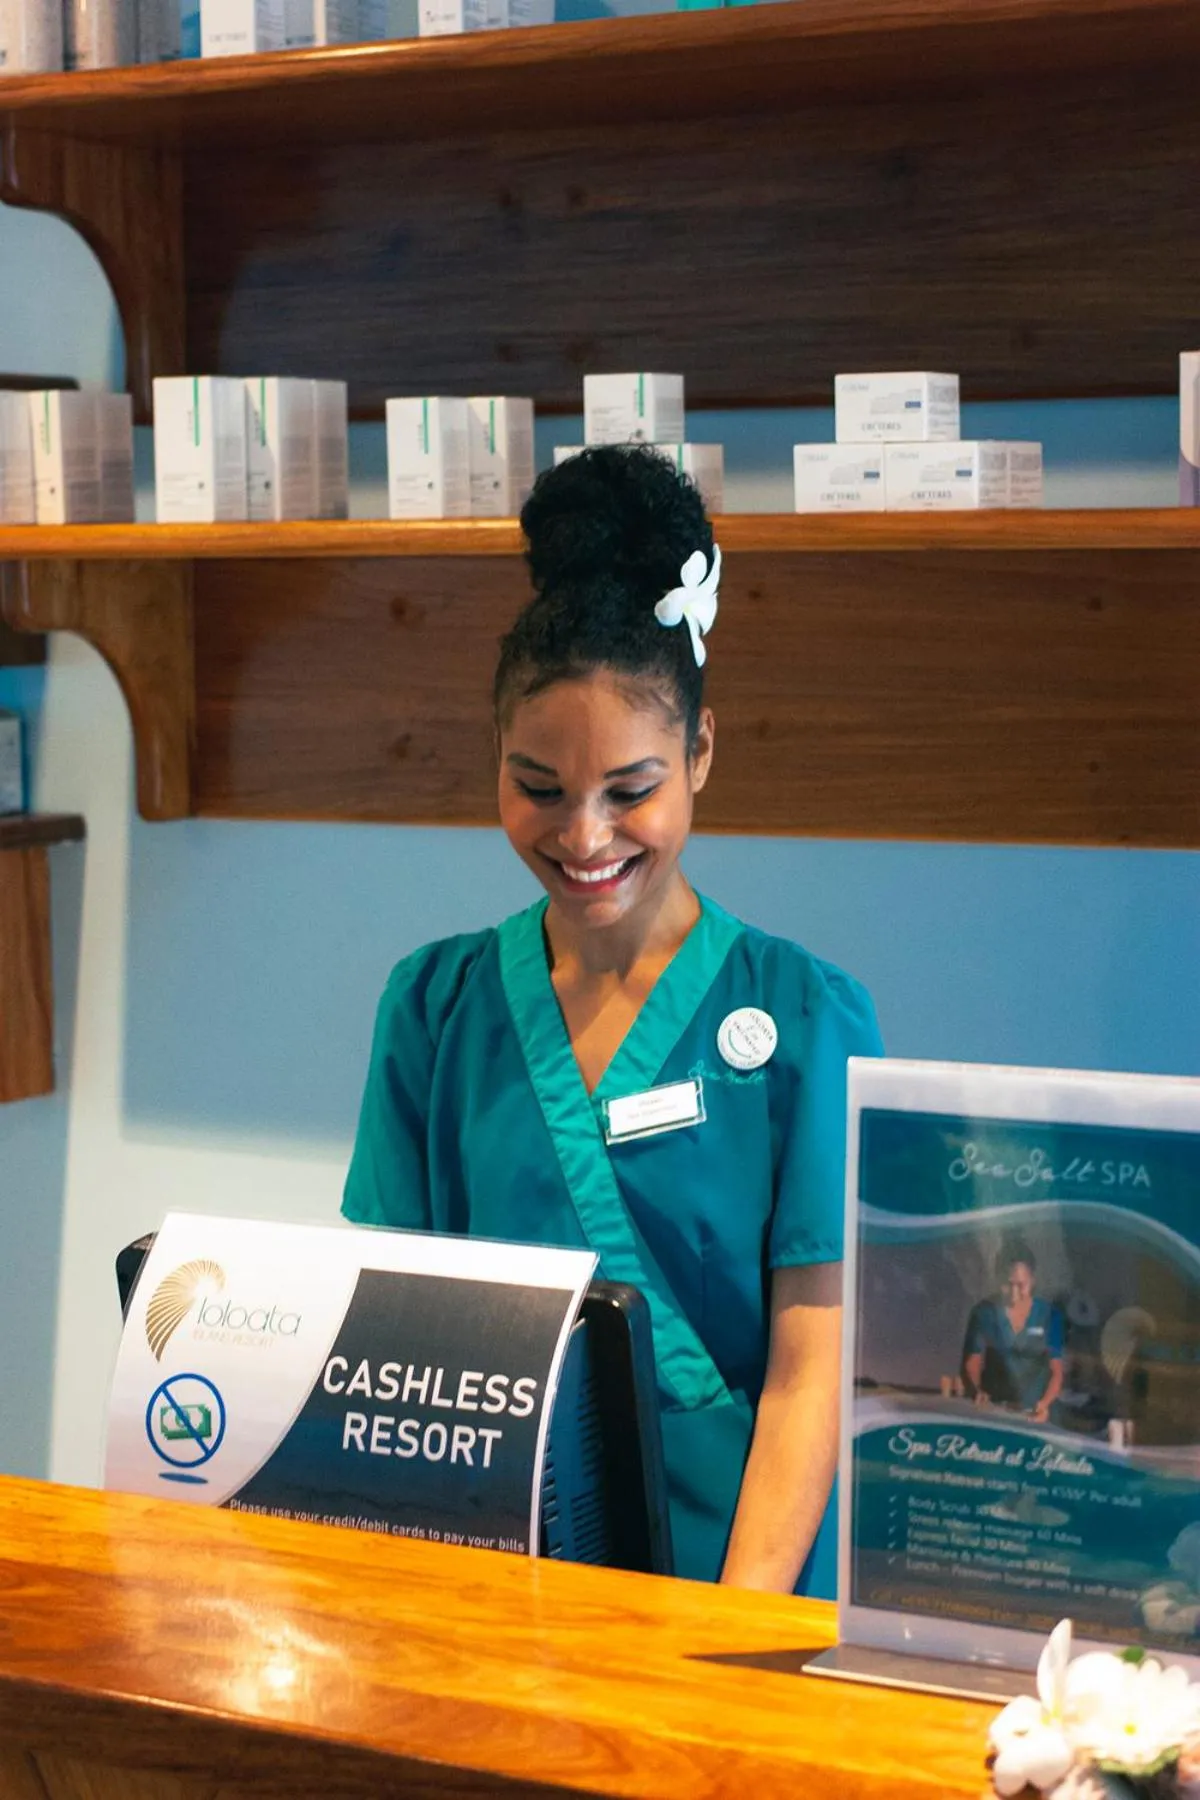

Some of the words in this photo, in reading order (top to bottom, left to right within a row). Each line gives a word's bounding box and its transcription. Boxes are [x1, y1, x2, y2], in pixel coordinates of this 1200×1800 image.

[949, 1143, 1012, 1181] Sea
[1014, 1149, 1095, 1187] Salt
[1101, 1161, 1151, 1188] SPA
[197, 1296, 302, 1336] loloata
[322, 1355, 538, 1418] CASHLESS
[342, 1411, 503, 1469] RESORT
[888, 1428, 931, 1460] Spa
[229, 1499, 267, 1517] Please
[271, 1506, 291, 1520] use
[294, 1511, 320, 1524] your
[323, 1513, 389, 1535] credit/debit
[392, 1523, 426, 1538] cards
[428, 1527, 440, 1541] to
[443, 1532, 465, 1546] pay
[468, 1534, 495, 1548] your
[499, 1535, 526, 1552] bills
